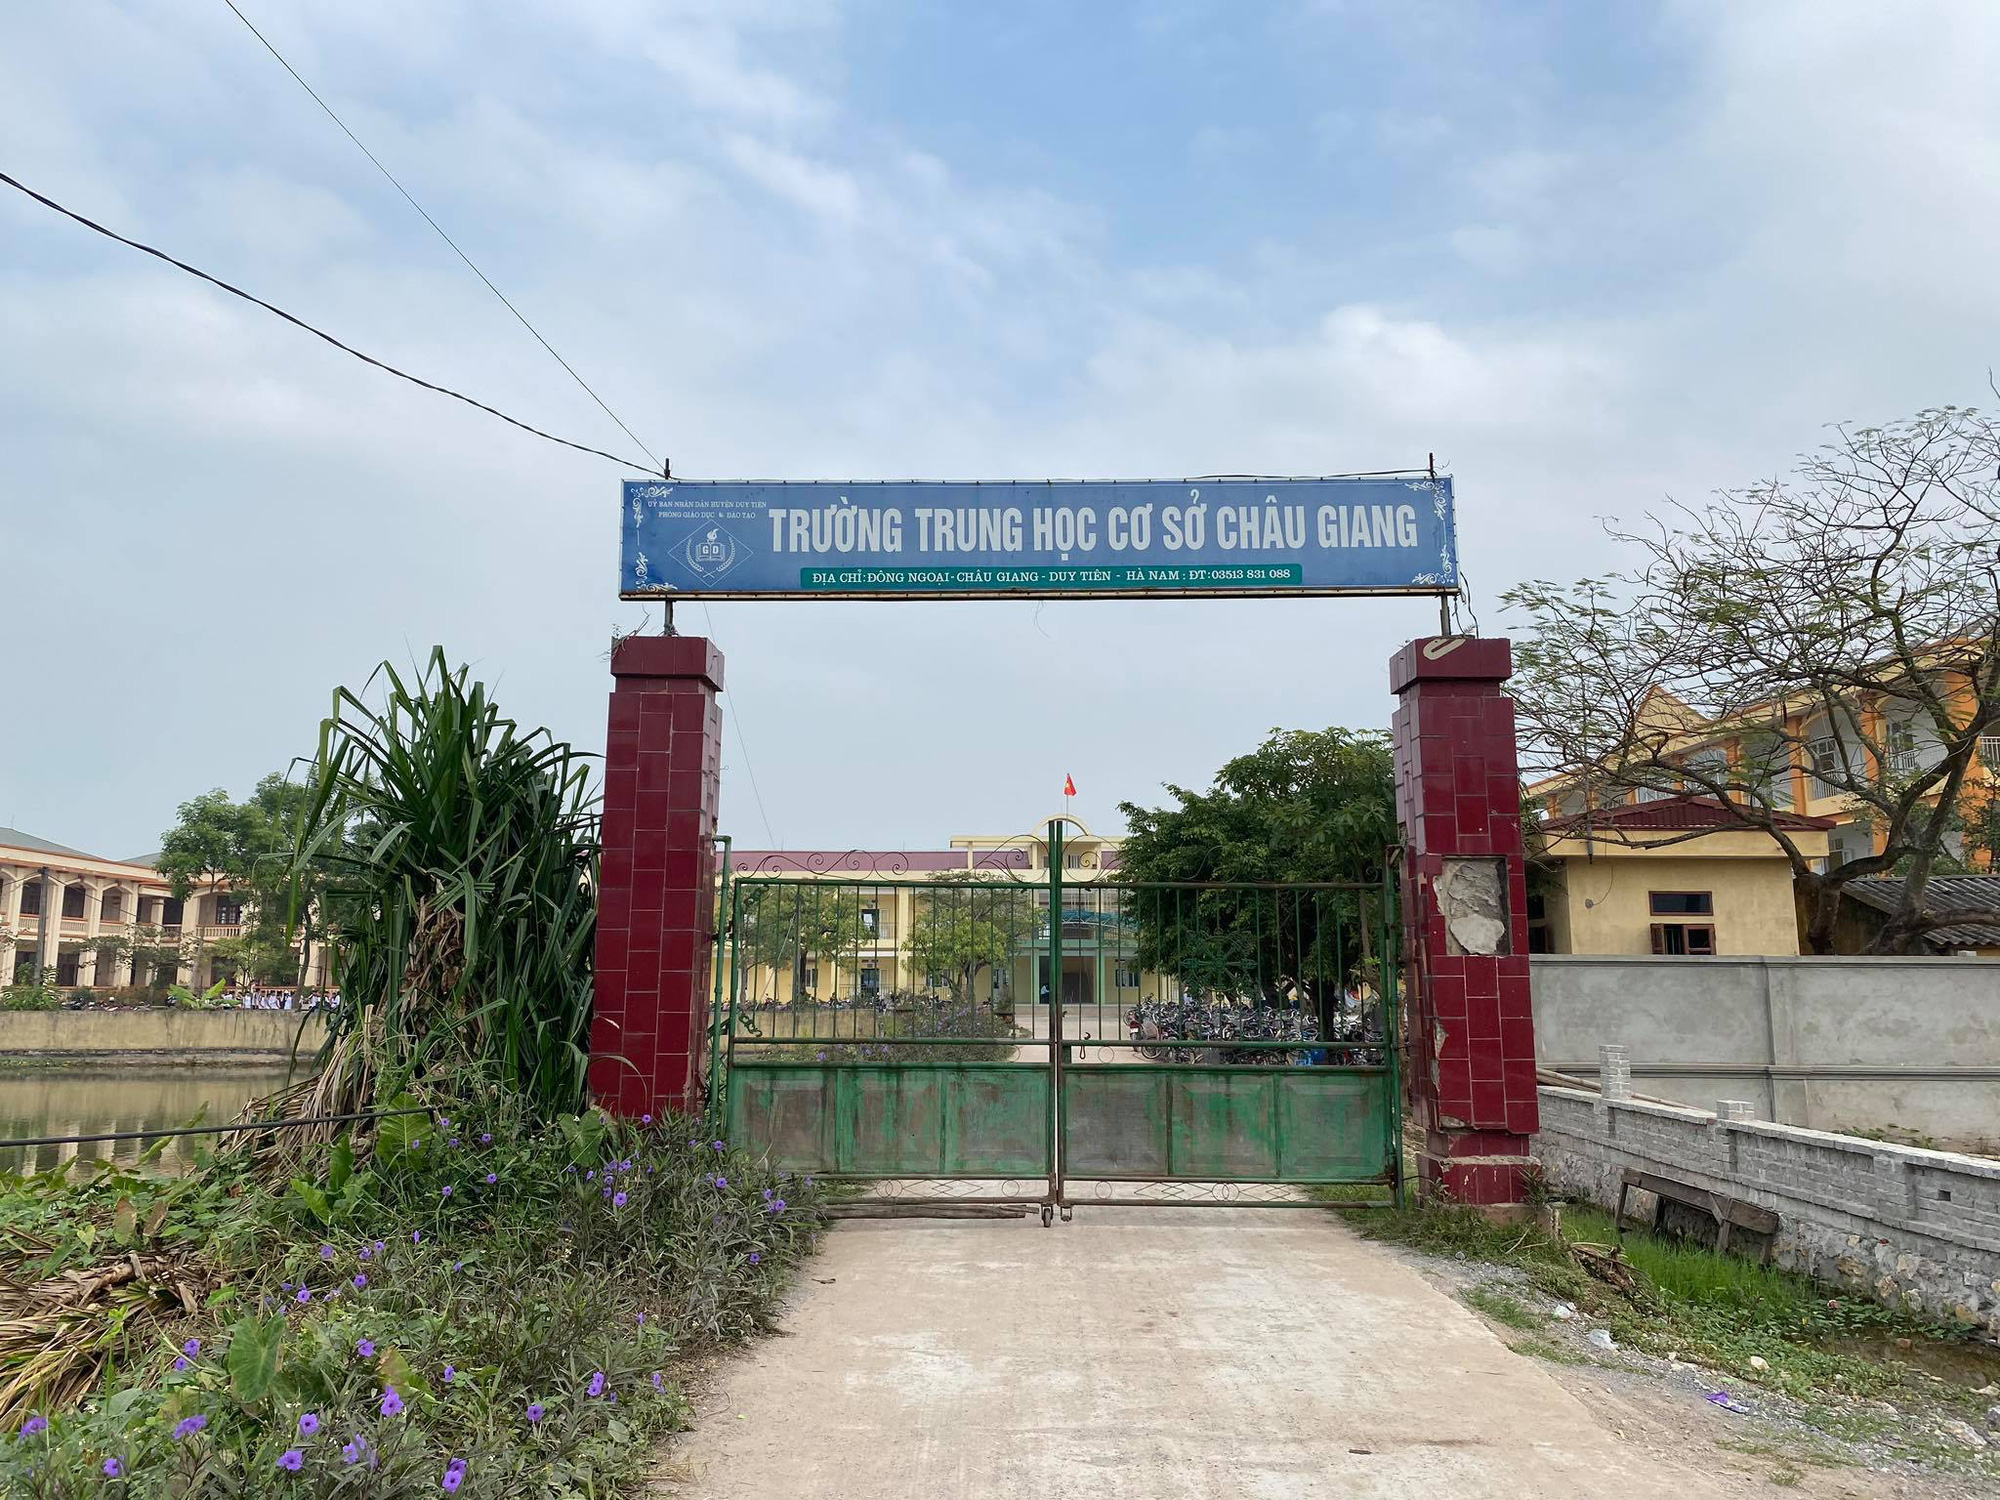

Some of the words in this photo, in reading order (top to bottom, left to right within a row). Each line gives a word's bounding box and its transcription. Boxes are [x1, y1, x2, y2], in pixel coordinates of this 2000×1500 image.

[674, 500, 694, 508] NHÂN
[768, 496, 903, 554] TRƯỜNG
[914, 507, 1023, 553] TRUNG
[1033, 506, 1097, 562] HỌC
[1107, 502, 1153, 551] CƠ
[1162, 488, 1208, 551] SỞ
[1216, 495, 1307, 549] CHÂU
[1317, 504, 1419, 548] GIANG
[812, 572, 836, 586] ĐỊA
[996, 572, 1039, 582] GIANG
[1049, 571, 1077, 582] DUY
[1079, 569, 1112, 581] TIÊN
[1126, 567, 1145, 581] HÀ
[1148, 570, 1179, 581] NAM
[1246, 569, 1266, 579] 831
[1269, 568, 1291, 579] 088
